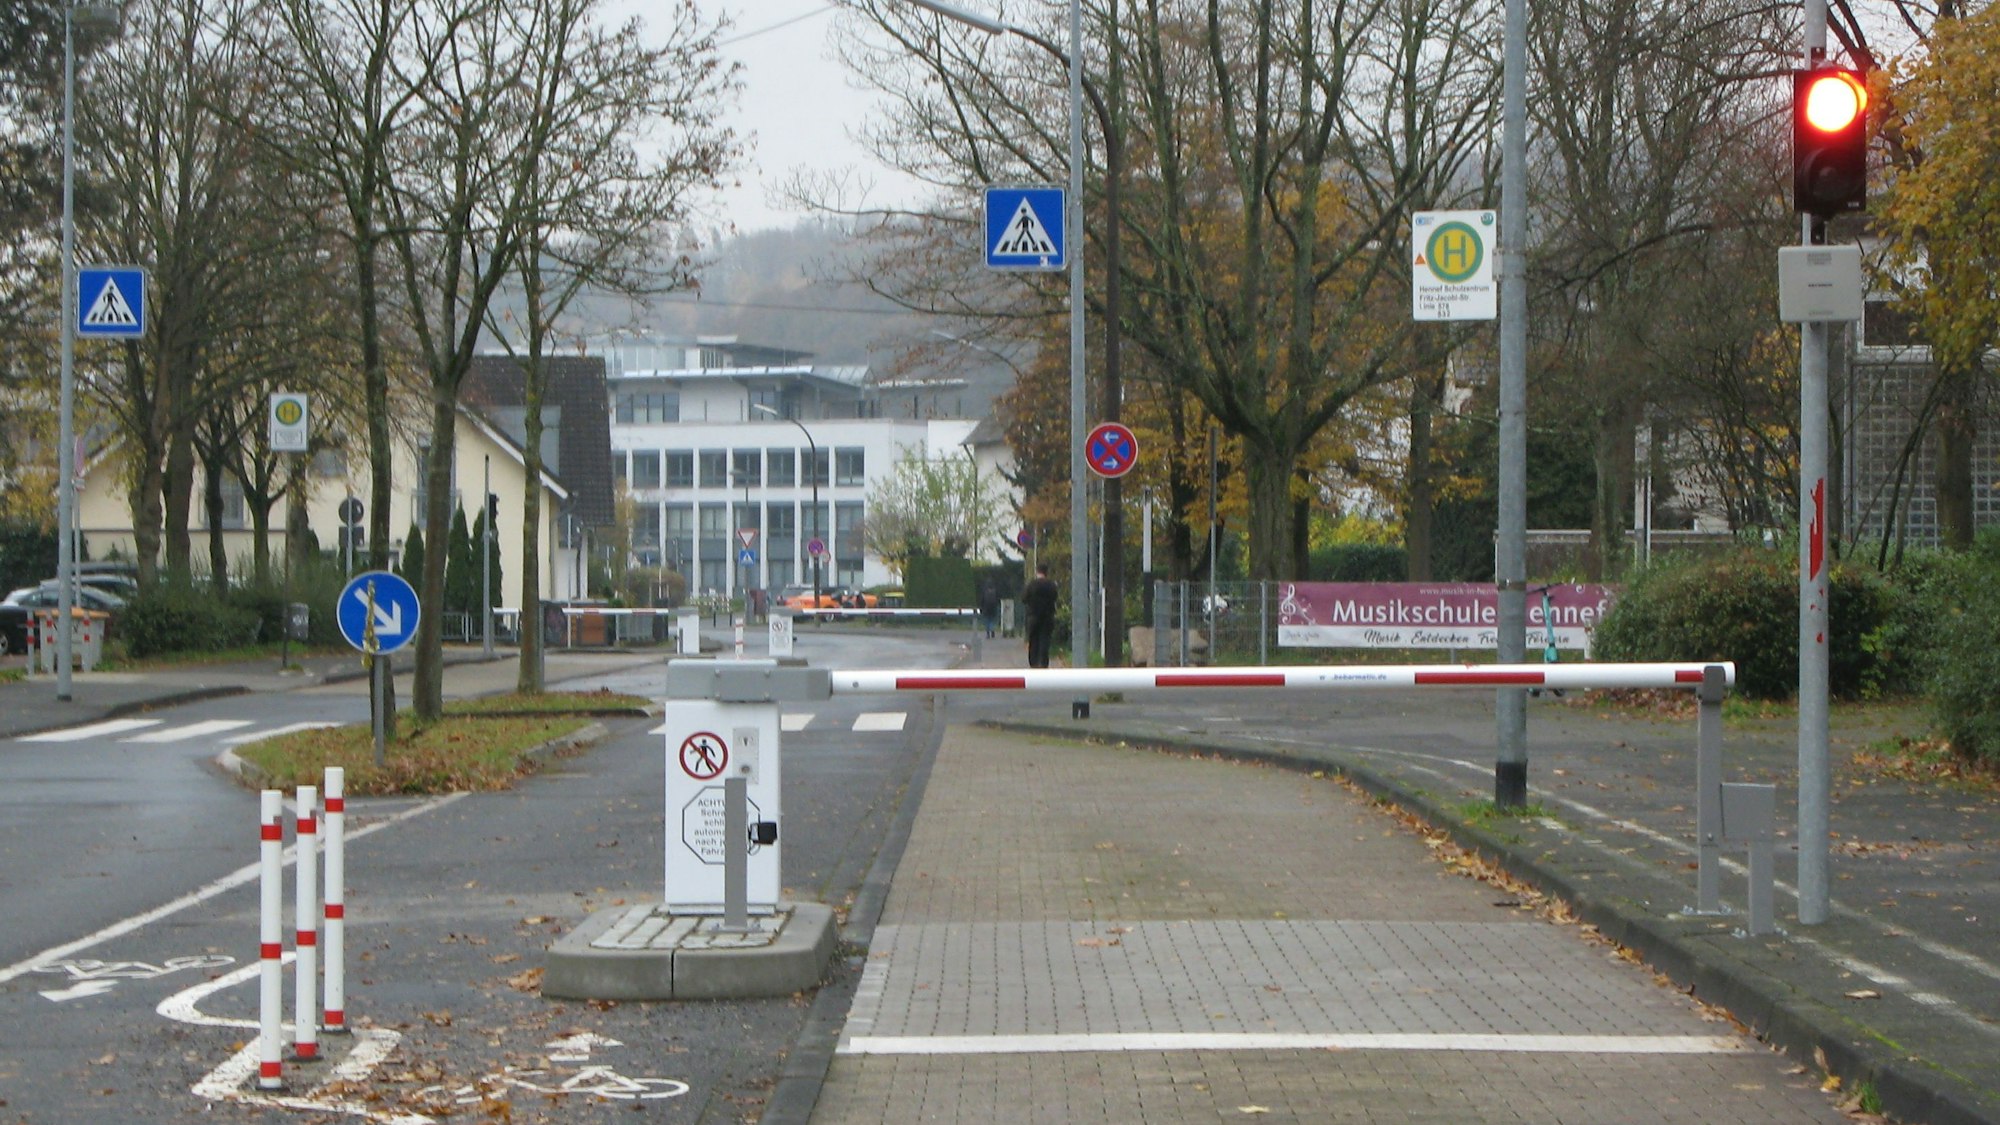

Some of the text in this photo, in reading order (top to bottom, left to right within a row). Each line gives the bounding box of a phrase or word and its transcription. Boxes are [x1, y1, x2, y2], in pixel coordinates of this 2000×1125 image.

[1443, 235, 1467, 269] H
[1420, 586, 1498, 596] www.musik-in-henn
[1333, 598, 1608, 624] Musikschule ennef
[1364, 629, 1401, 645] Musik
